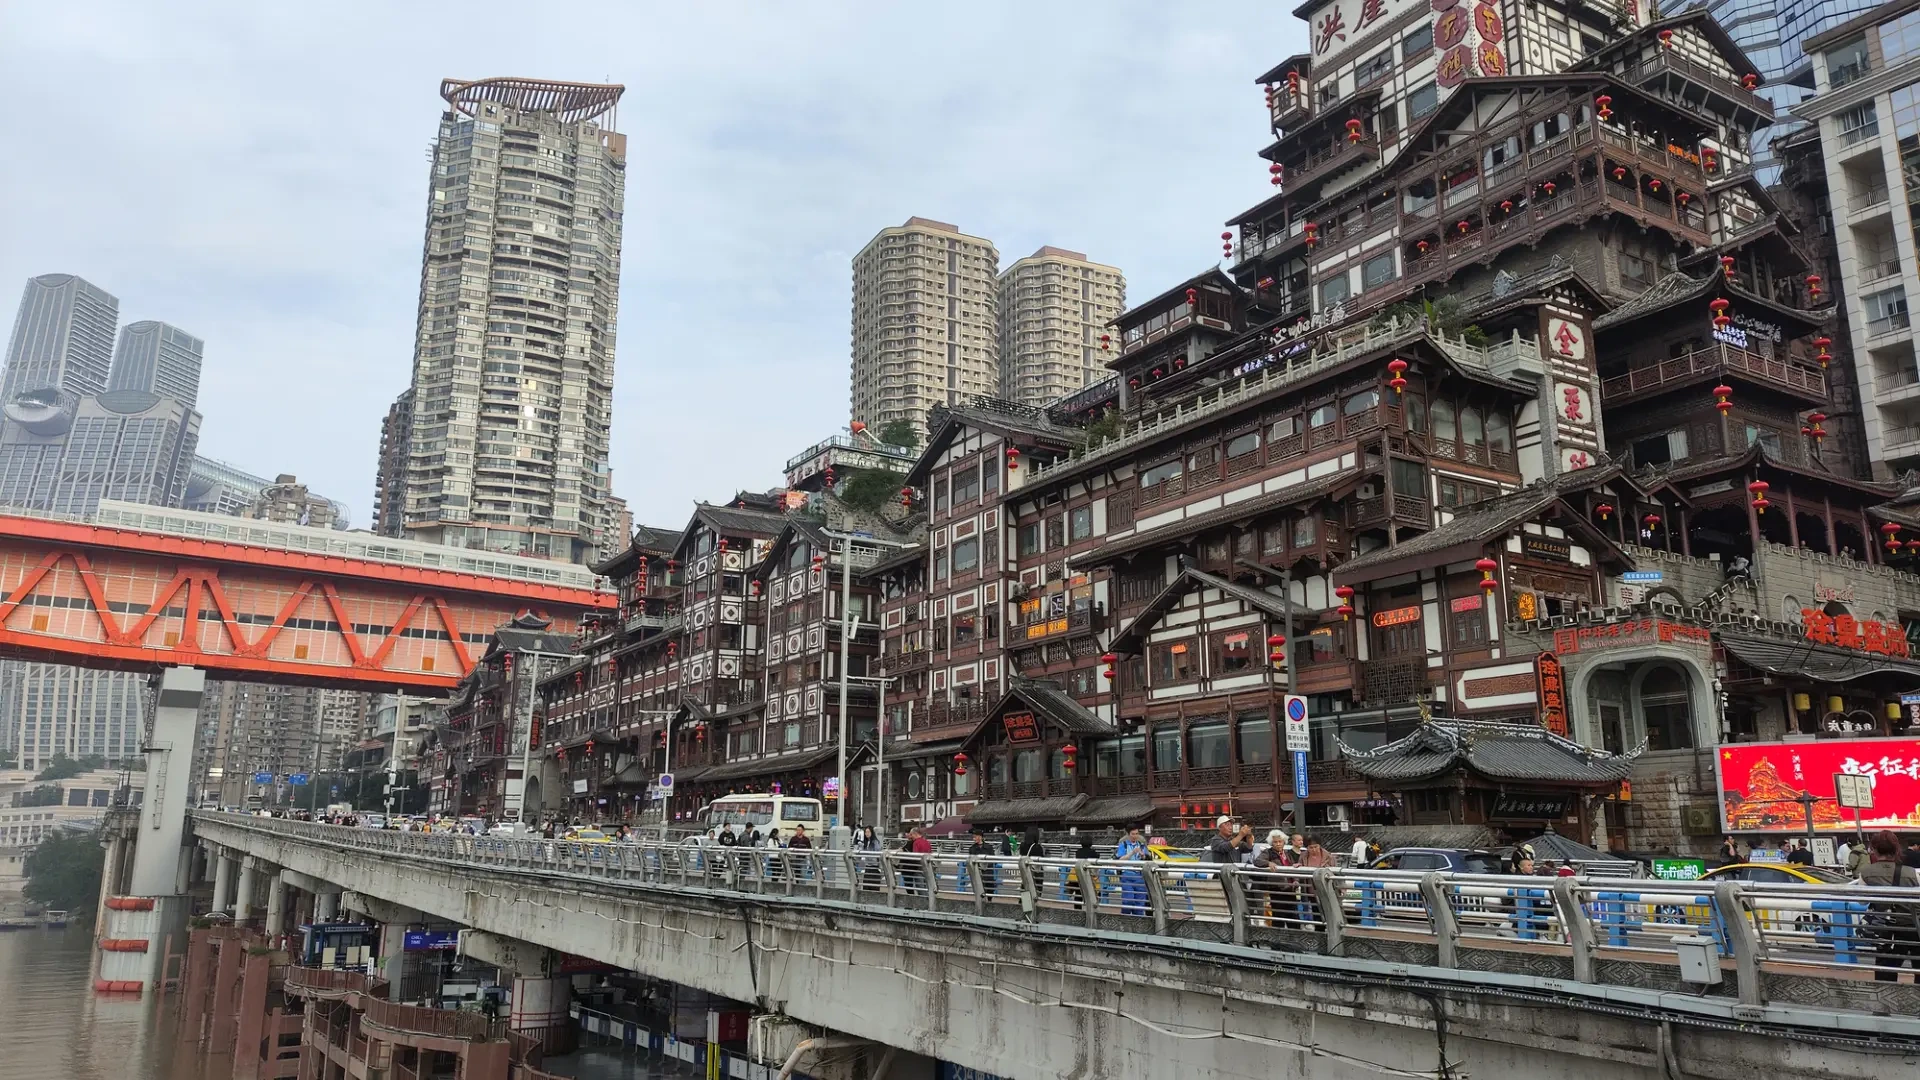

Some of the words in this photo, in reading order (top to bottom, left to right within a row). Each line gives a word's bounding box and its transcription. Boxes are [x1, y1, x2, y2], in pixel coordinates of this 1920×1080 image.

[1578, 619, 1653, 640] 中华老字号
[1672, 623, 1711, 641] 中华老字号
